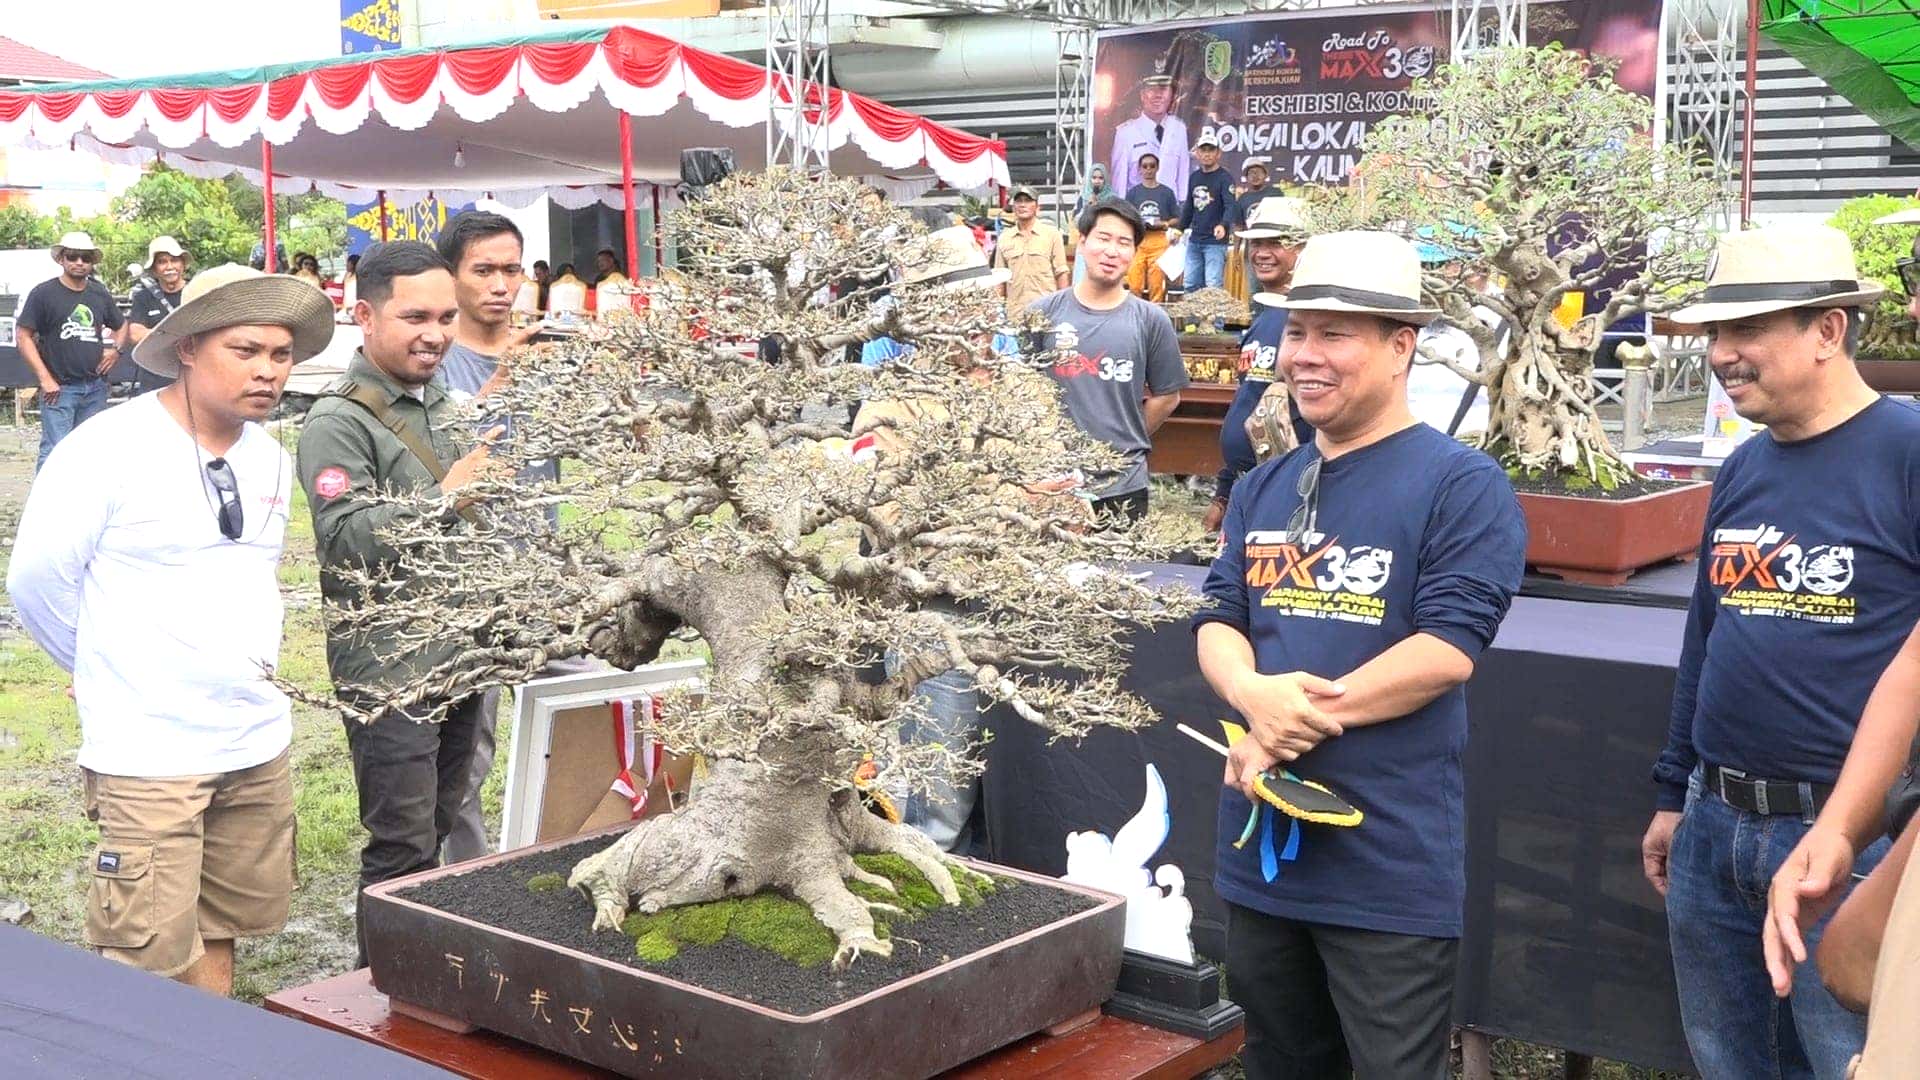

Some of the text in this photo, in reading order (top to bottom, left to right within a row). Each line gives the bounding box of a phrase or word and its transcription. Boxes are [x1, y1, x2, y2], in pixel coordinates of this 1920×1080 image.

[1322, 30, 1390, 52] Road To
[1246, 93, 1343, 116] EKSHIBISI
[1344, 92, 1364, 112] &
[1732, 589, 1855, 607] HARMONY BONSAI
